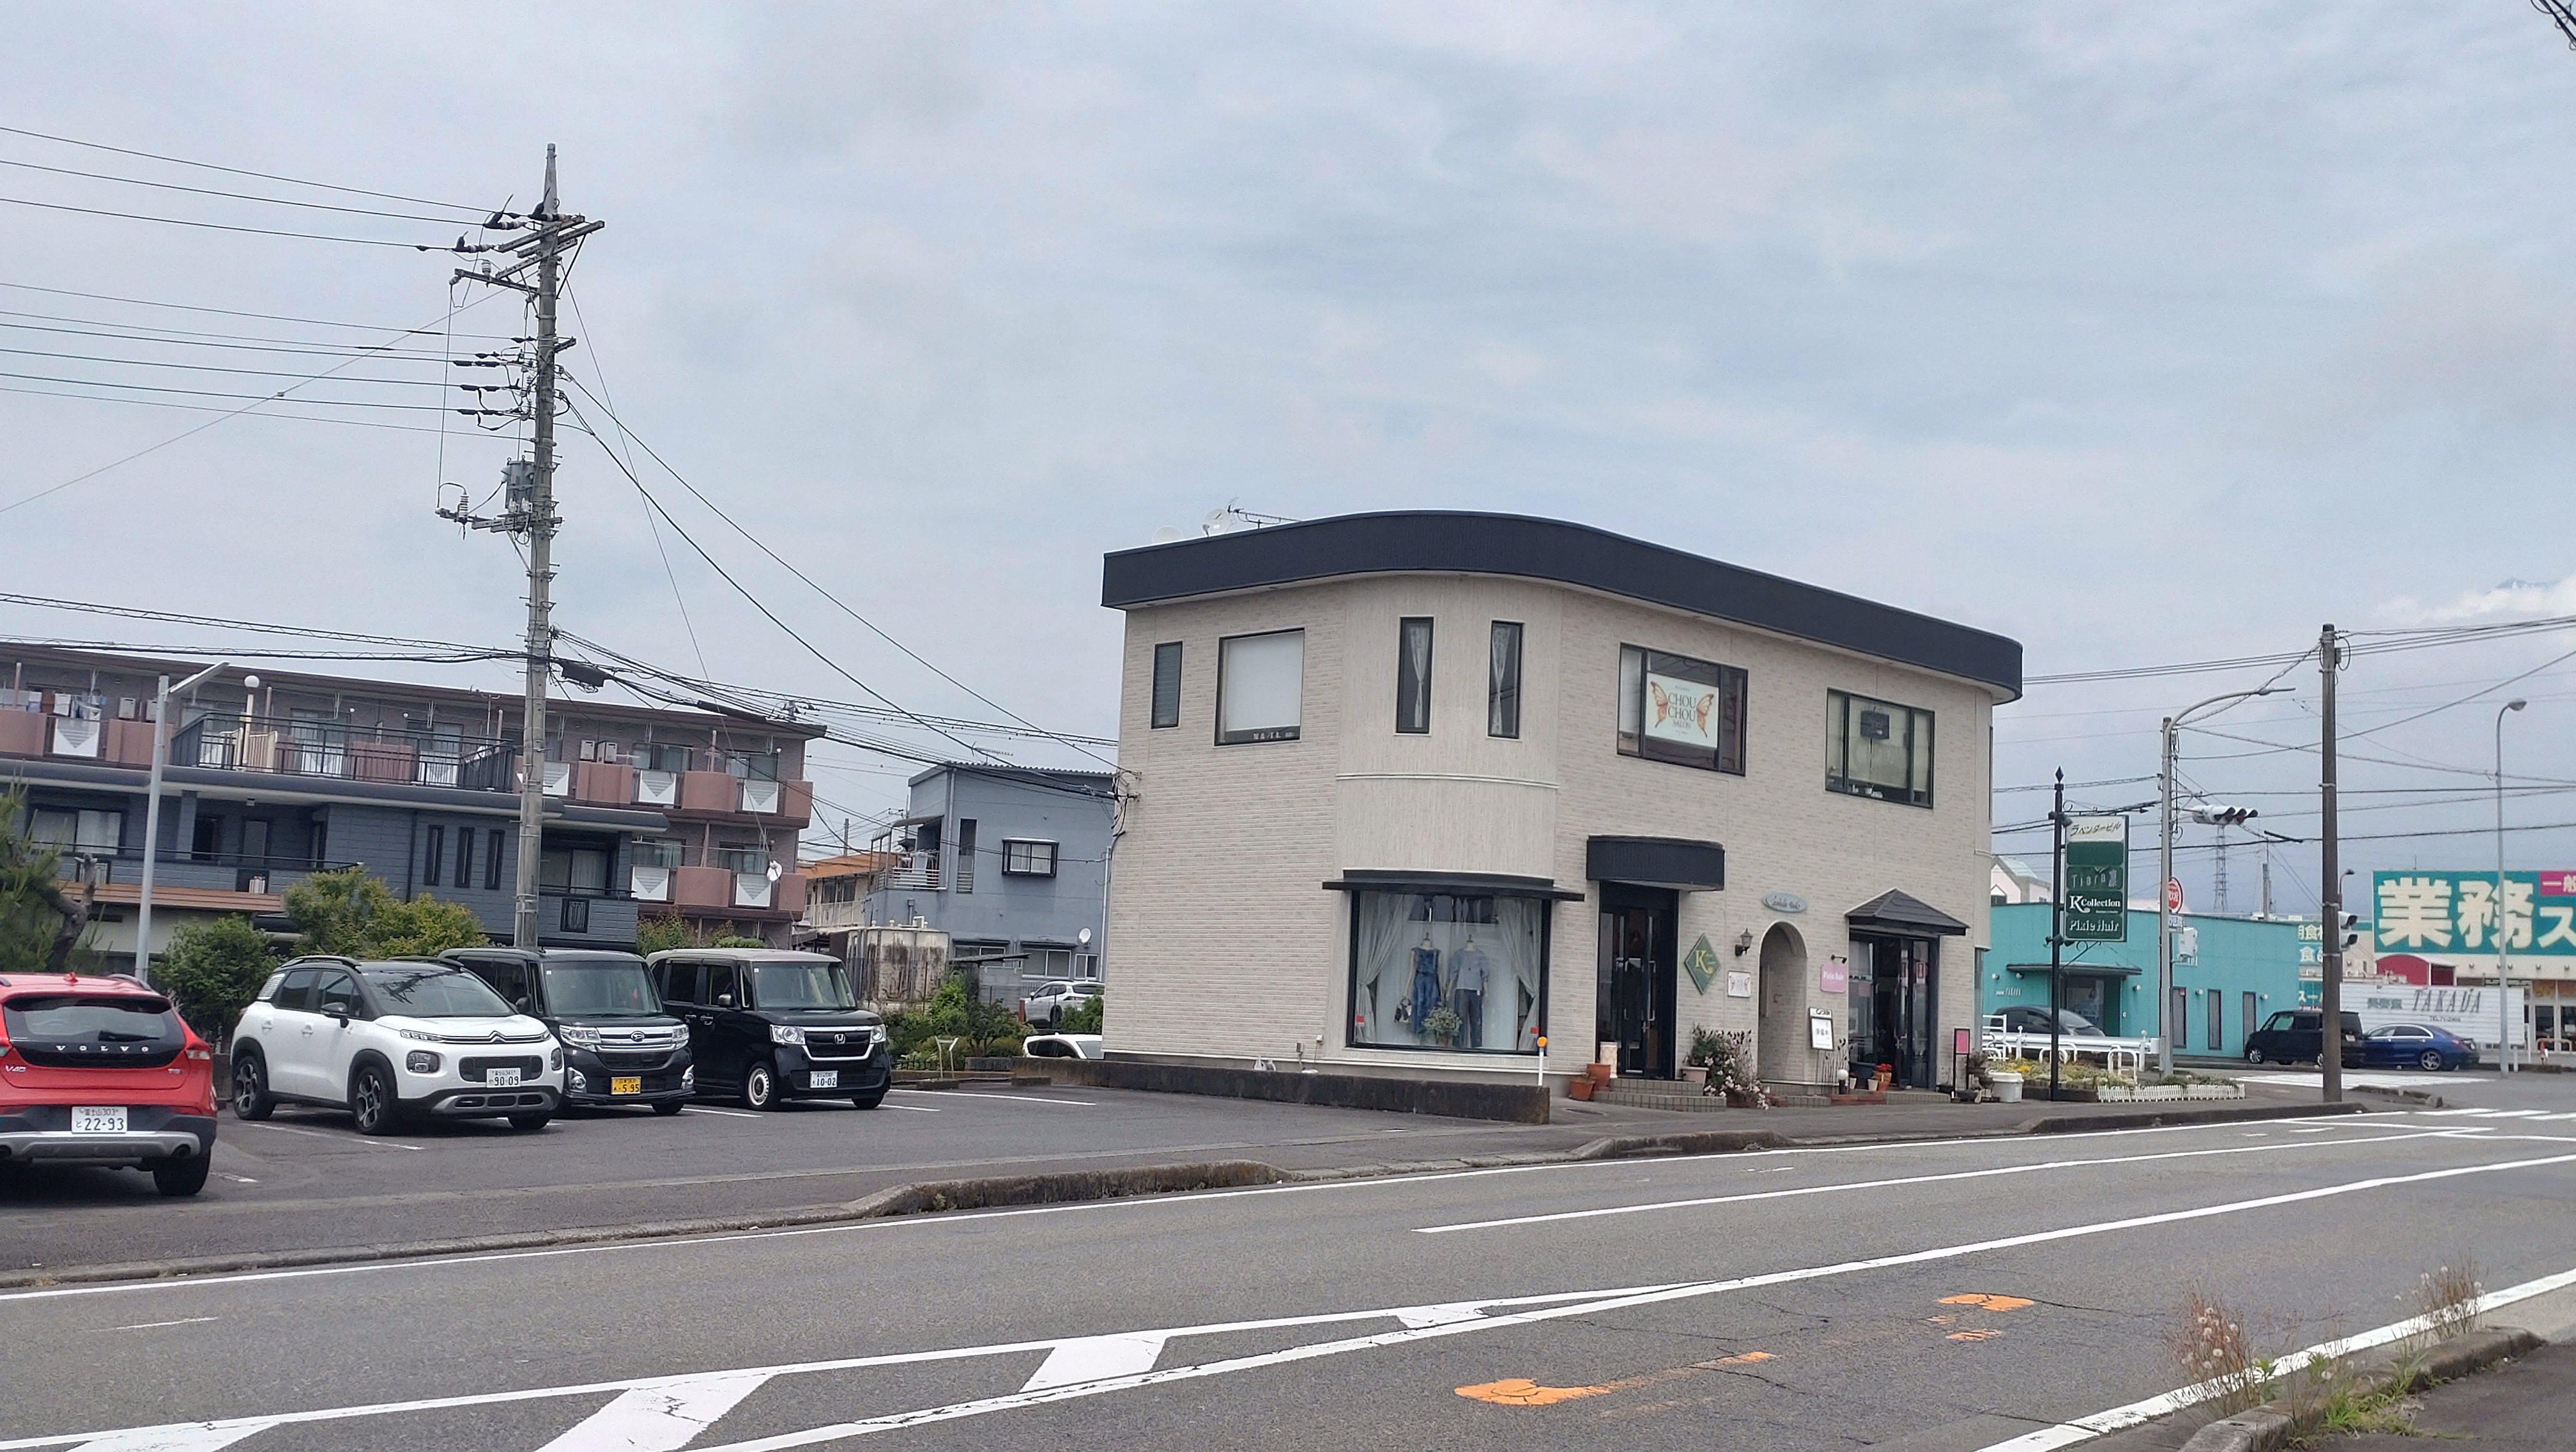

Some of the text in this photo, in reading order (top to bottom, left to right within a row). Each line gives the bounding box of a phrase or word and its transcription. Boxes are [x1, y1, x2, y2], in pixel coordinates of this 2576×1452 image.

[1668, 692, 1696, 708] CHOU
[1667, 706, 1696, 722] CHOU
[2070, 822, 2121, 836] ラベンダービル
[2069, 895, 2120, 913] K Collection
[1695, 950, 1713, 975] K
[816, 1077, 836, 1086] 10-02
[84, 1117, 124, 1131] 22-93
